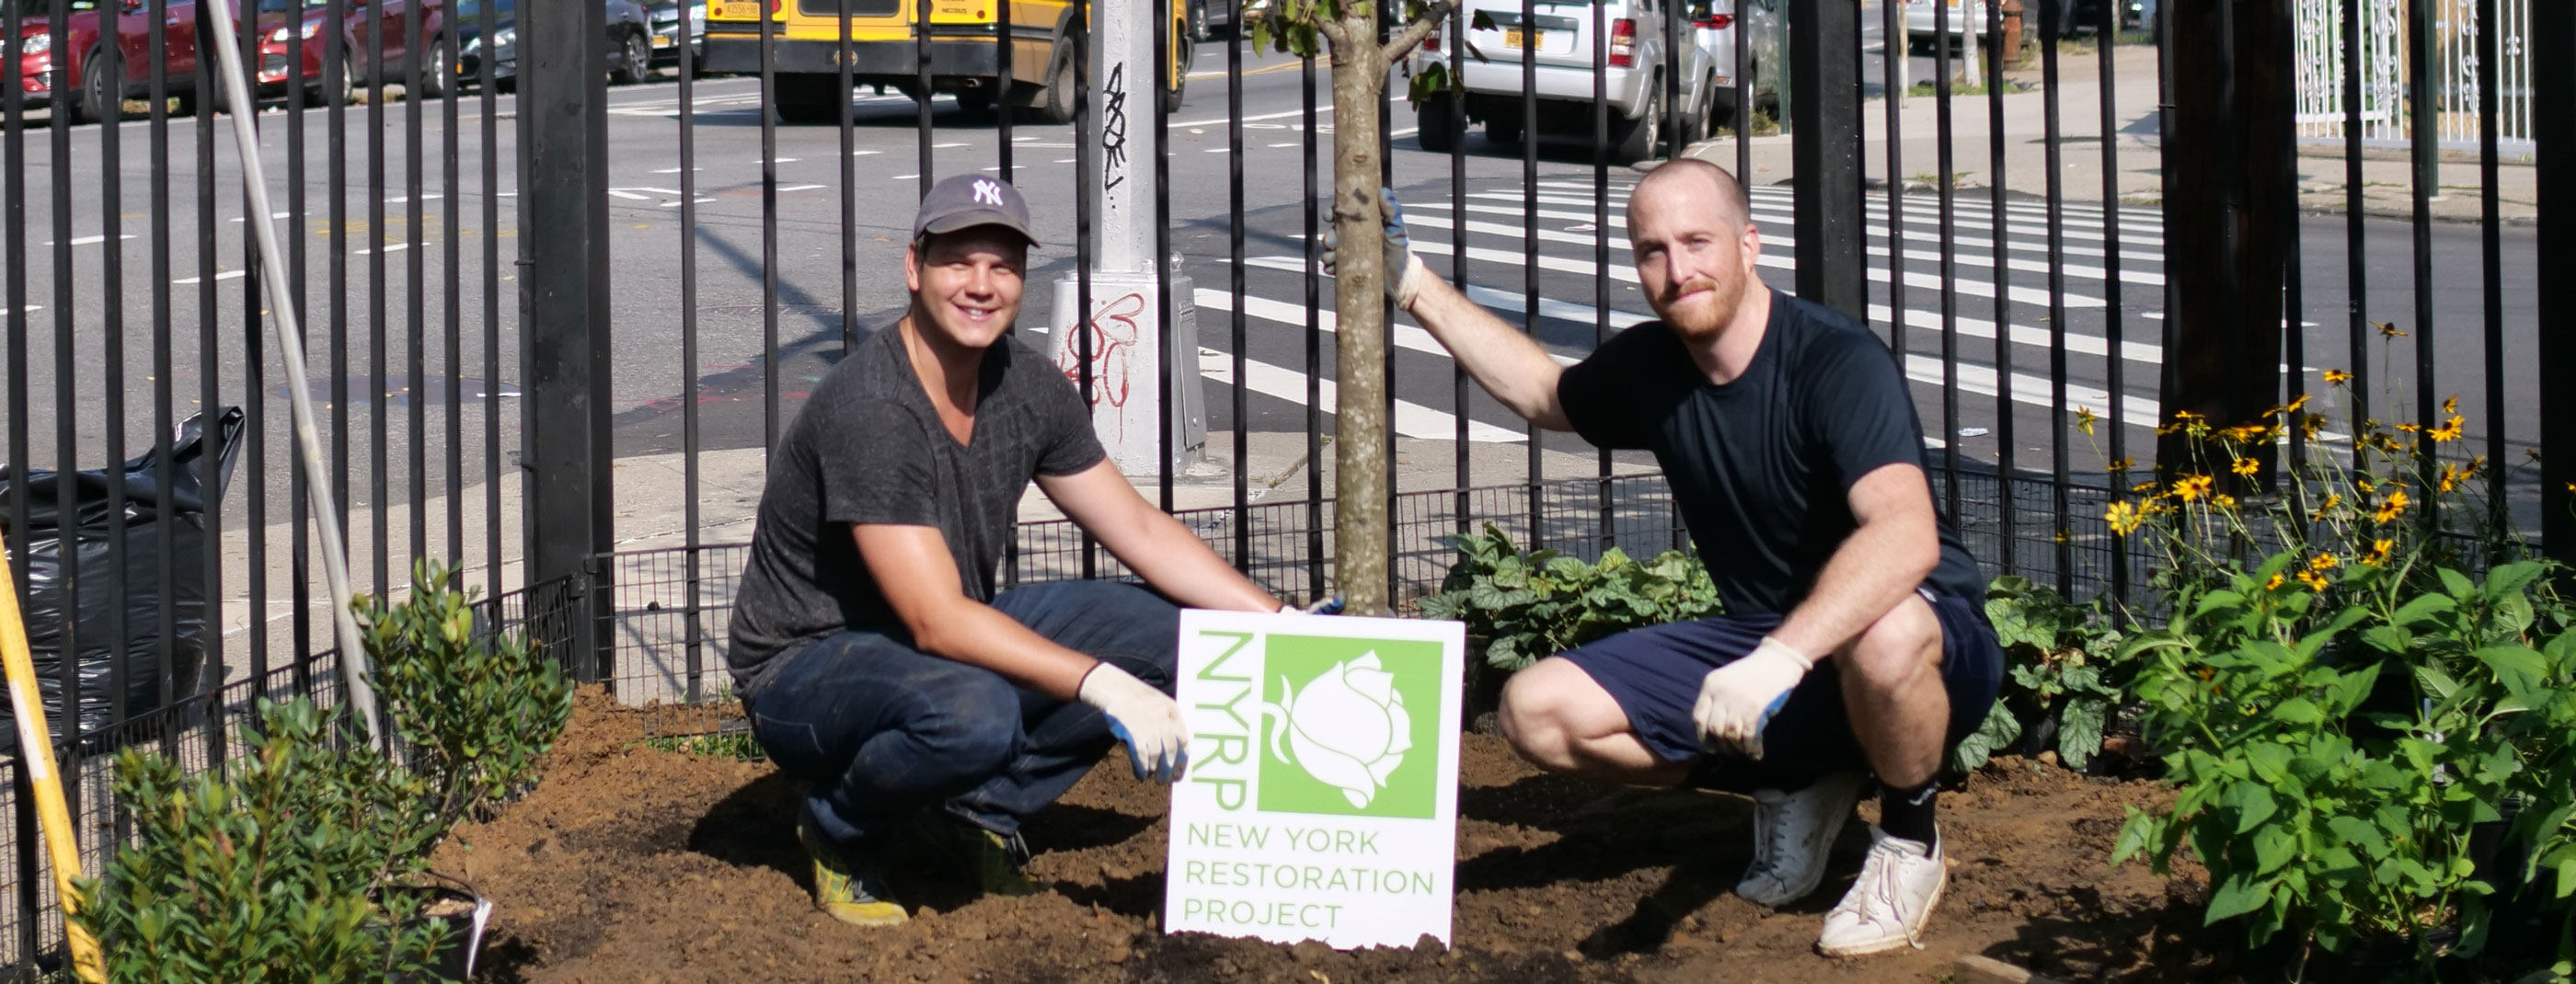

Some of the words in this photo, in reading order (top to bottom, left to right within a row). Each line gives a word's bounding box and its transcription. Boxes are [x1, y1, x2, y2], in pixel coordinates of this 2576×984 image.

[972, 179, 1004, 206] NY
[1190, 629, 1254, 812] NYRP
[1188, 823, 1271, 849] NEW
[1284, 827, 1381, 854] YORK
[1185, 861, 1434, 895] RESTORATION
[1183, 898, 1343, 929] PROJECT
